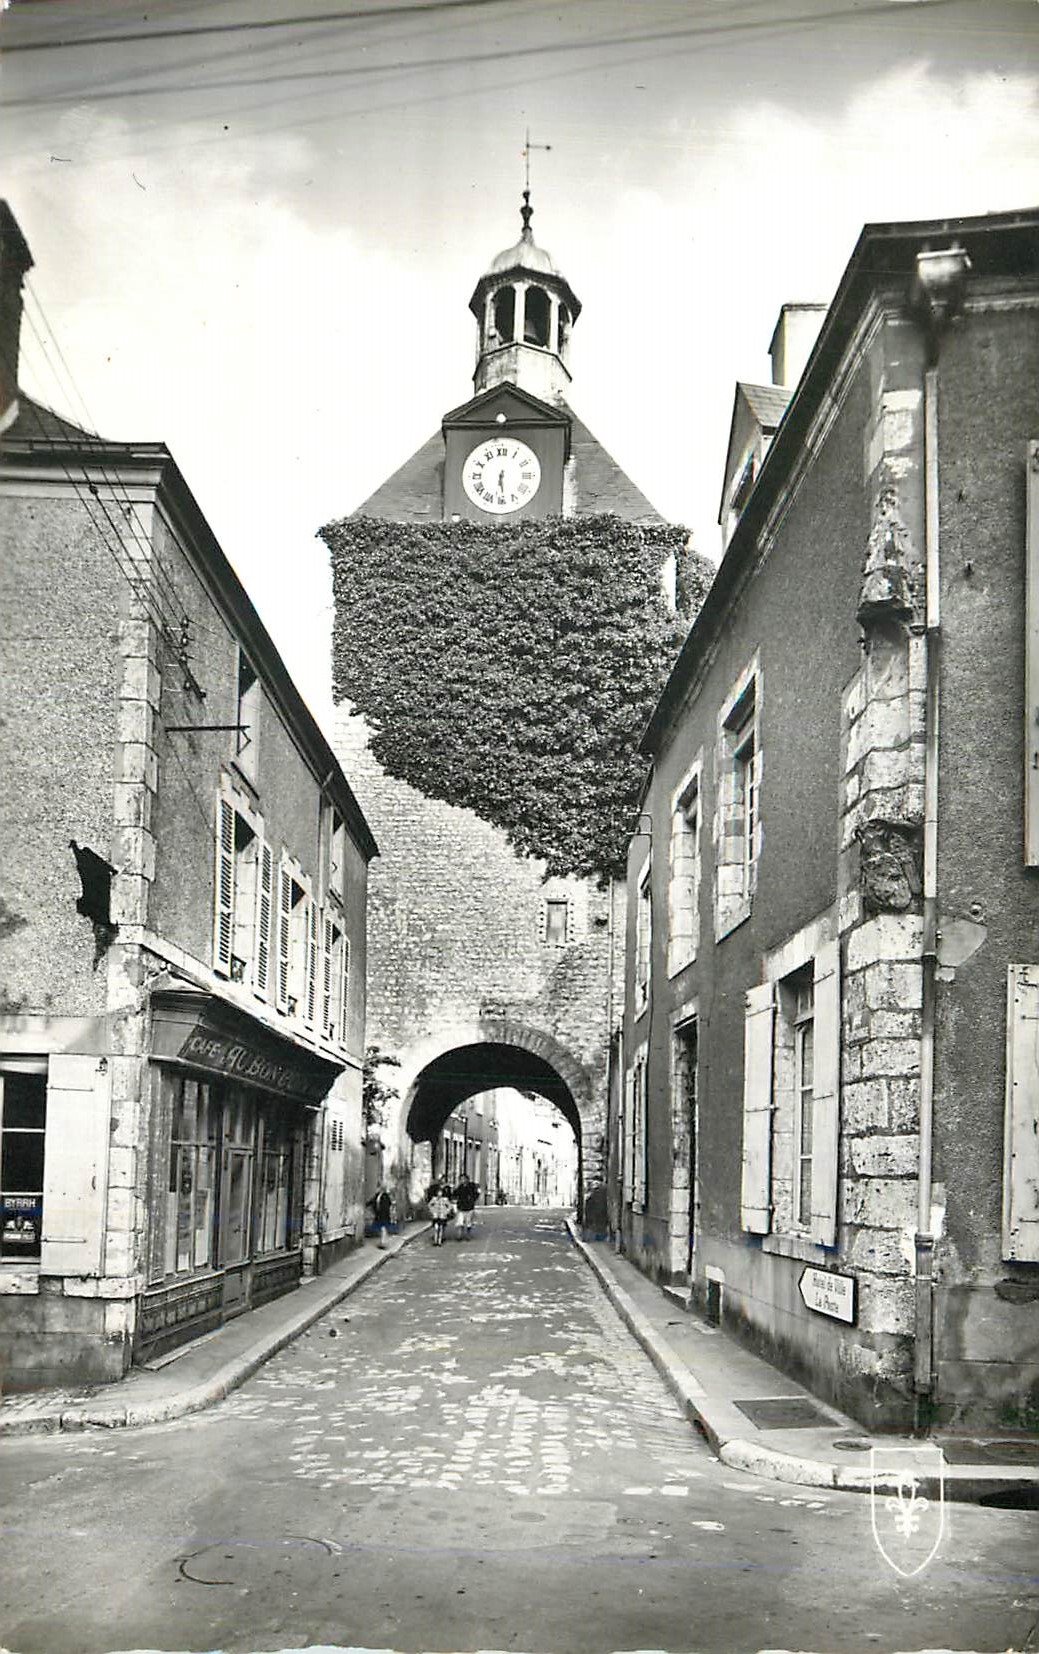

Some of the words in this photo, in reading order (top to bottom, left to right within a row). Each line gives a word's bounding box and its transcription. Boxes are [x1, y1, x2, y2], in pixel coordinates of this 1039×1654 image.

[484, 451, 494, 461] XI
[496, 448, 508, 457] XII
[512, 450, 518, 459] I
[476, 461, 485, 469] X
[519, 460, 529, 468] II
[472, 472, 482, 480] IX
[4, 1198, 36, 1208] BYRRH
